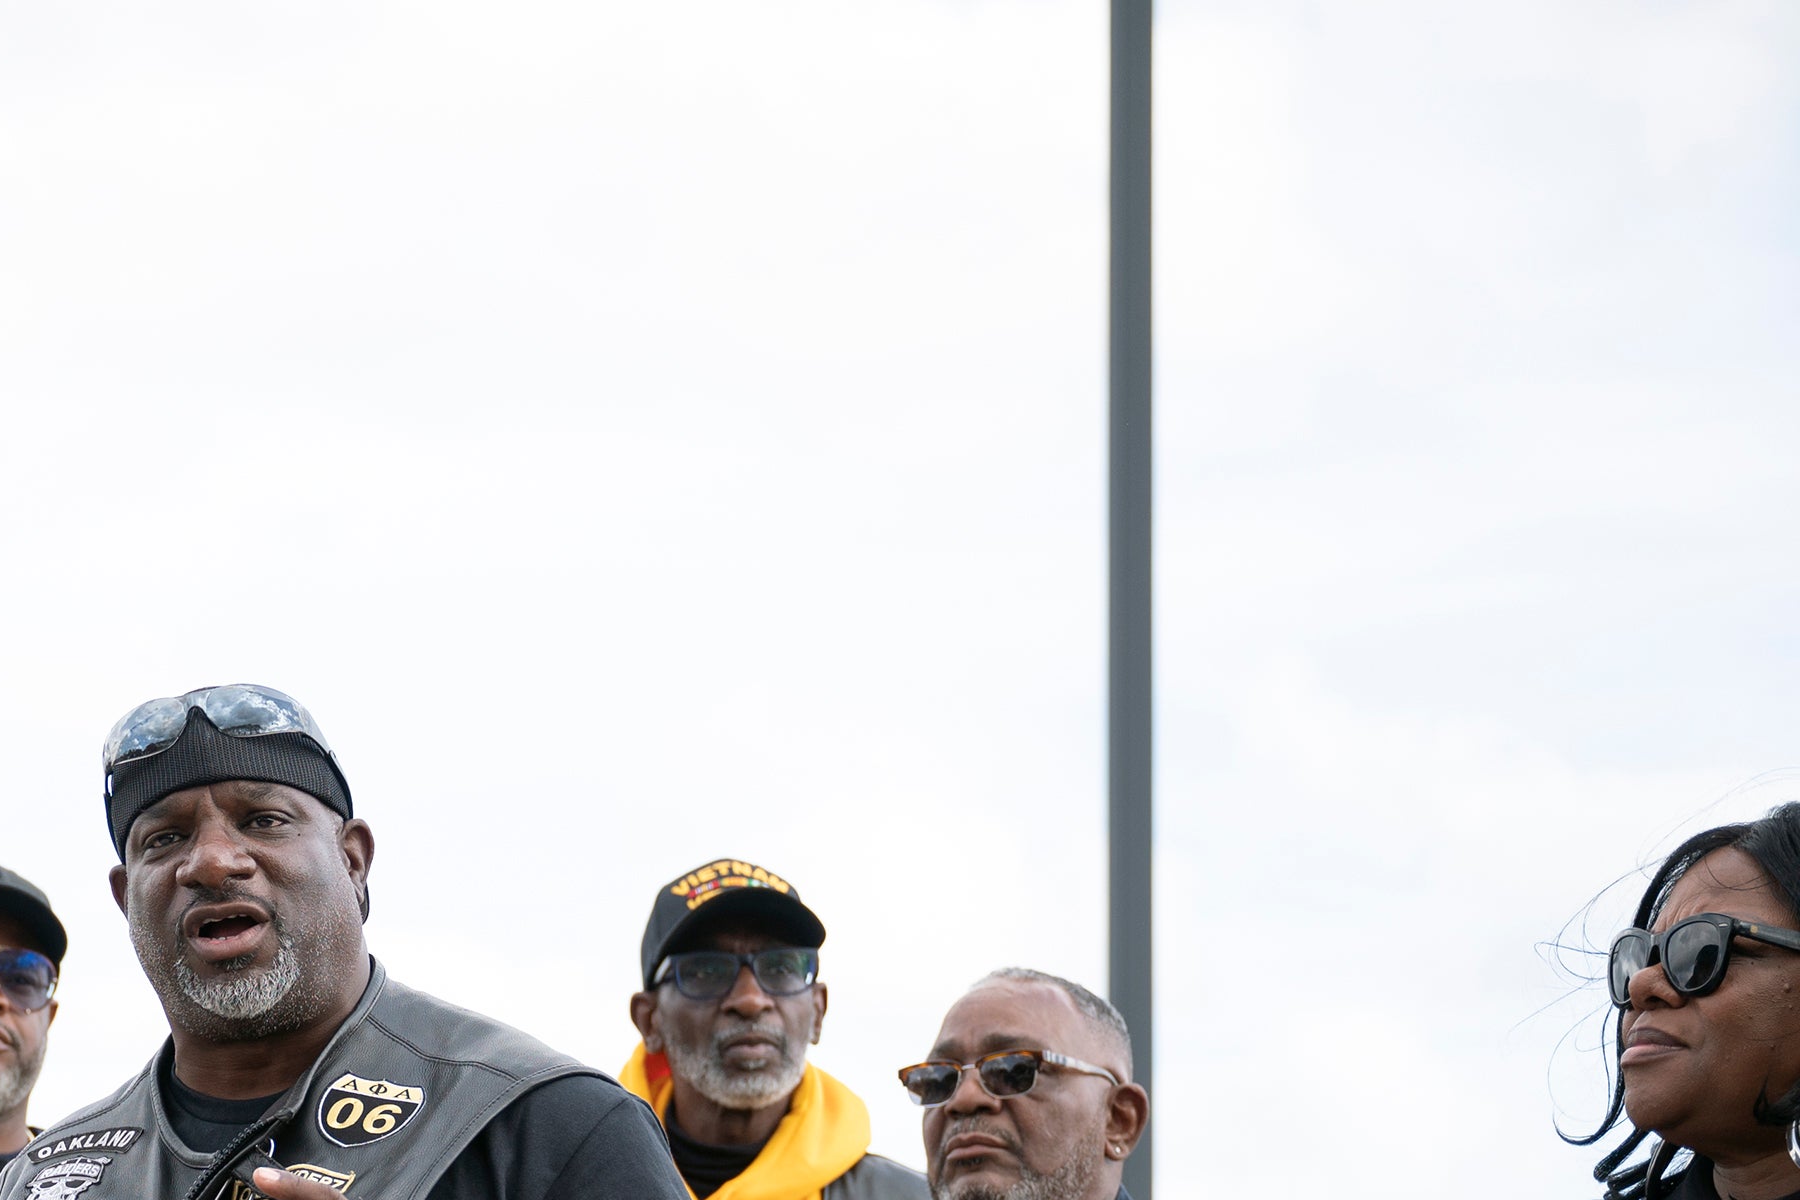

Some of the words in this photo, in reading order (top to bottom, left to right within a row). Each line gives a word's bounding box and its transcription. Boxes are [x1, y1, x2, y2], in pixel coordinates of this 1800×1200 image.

[670, 860, 790, 897] VIETNAM
[326, 1097, 403, 1134] 06
[37, 1129, 136, 1159] OAKLAND
[41, 1162, 100, 1179] RAIDERS
